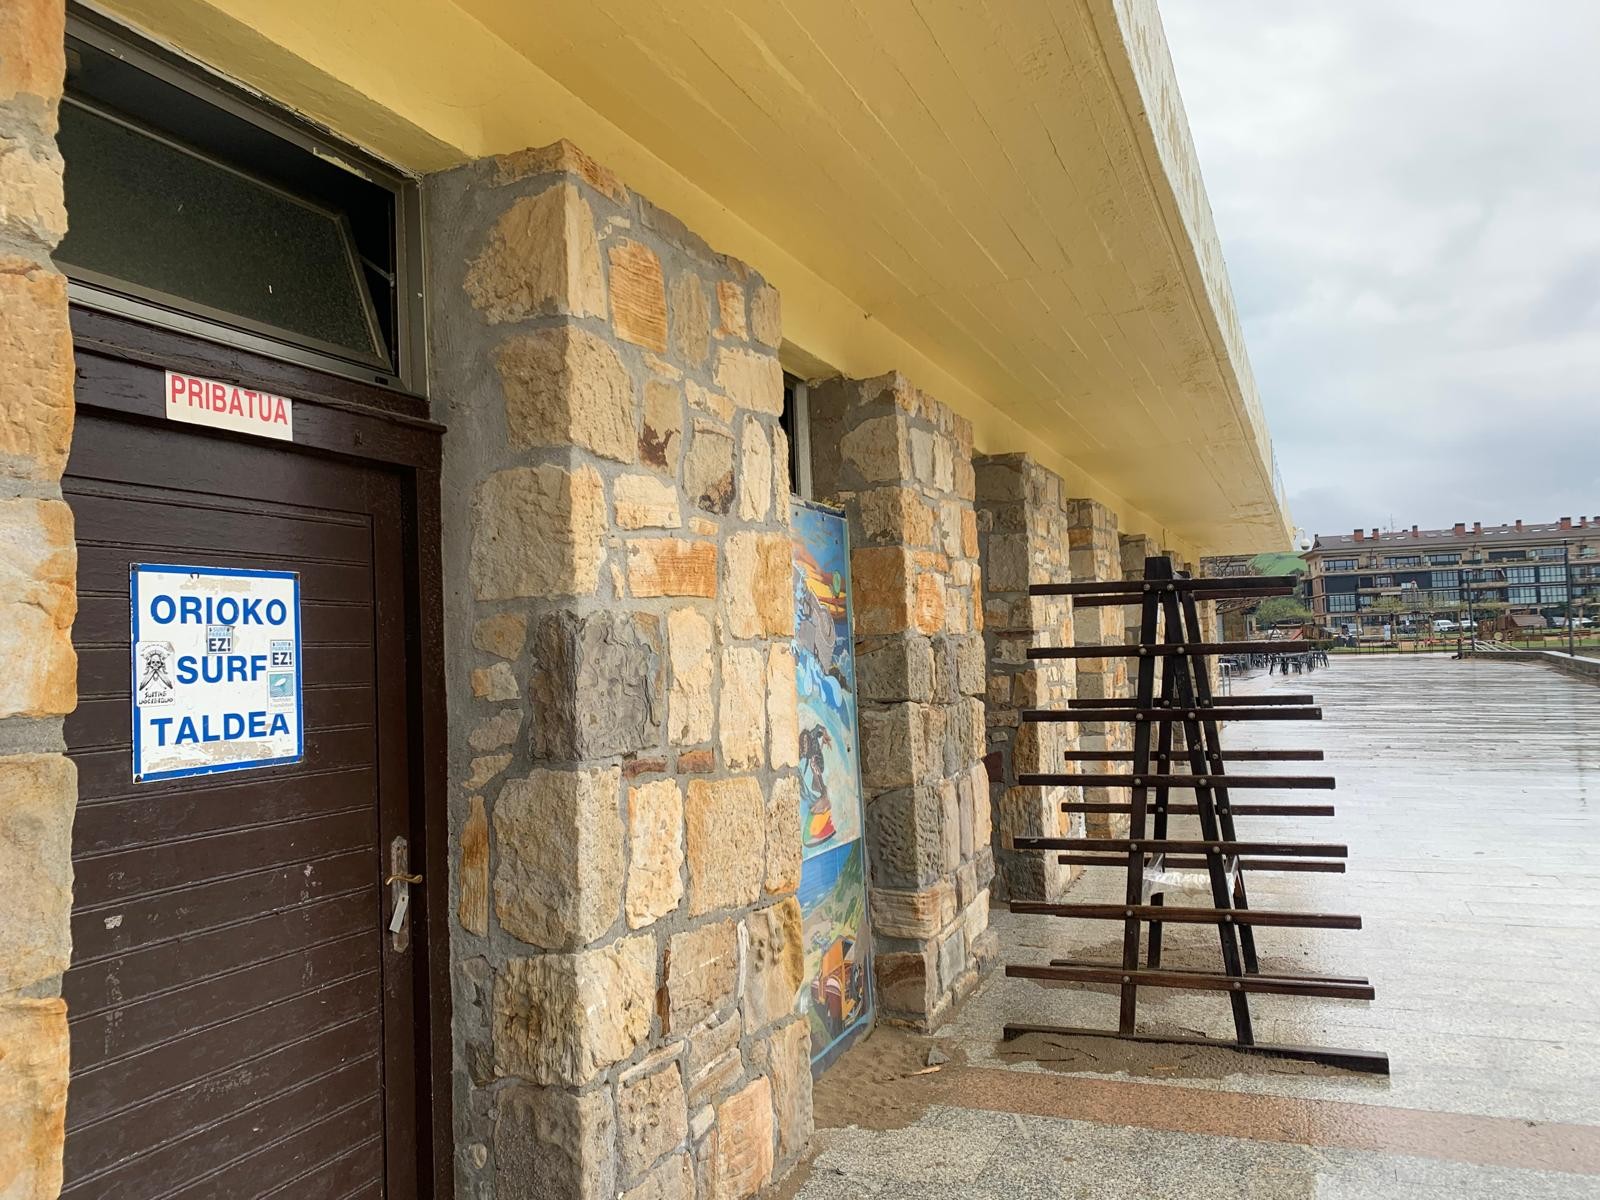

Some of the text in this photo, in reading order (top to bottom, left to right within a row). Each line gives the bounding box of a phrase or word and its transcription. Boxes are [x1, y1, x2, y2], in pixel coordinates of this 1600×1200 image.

[171, 374, 288, 425] PRIBATUA
[150, 594, 287, 626] ORIOKO
[209, 637, 231, 652] EZ!
[272, 652, 292, 666] EZ!
[176, 655, 267, 684] SURF
[150, 711, 290, 747] TALDEA
